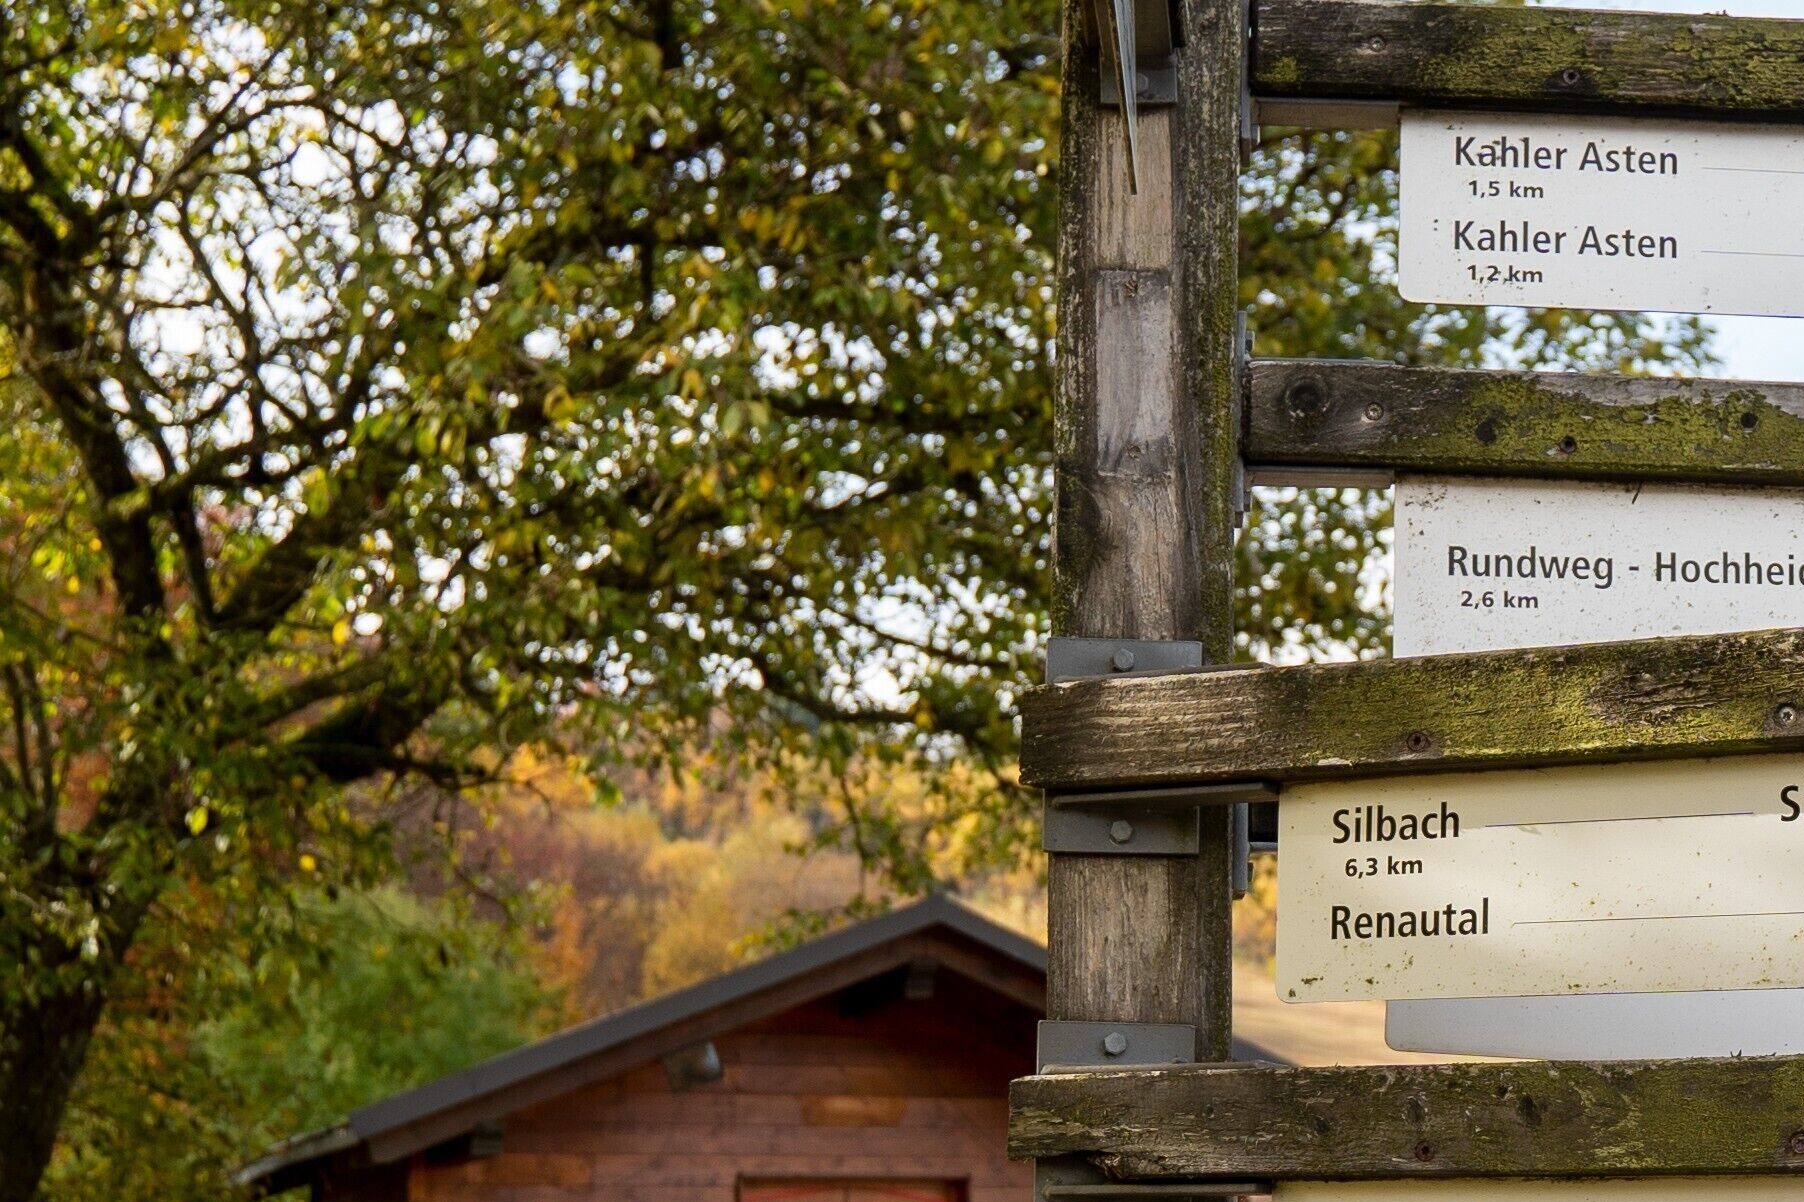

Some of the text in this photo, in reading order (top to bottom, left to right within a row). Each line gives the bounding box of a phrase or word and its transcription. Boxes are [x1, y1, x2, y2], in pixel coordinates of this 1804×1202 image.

[1455, 135, 1678, 175] Kahler Asten
[1468, 180, 1544, 199] 1,5 km
[1454, 219, 1677, 259] Kahler Asten
[1466, 264, 1543, 285] 1,2 km
[1448, 545, 1613, 590] Rundweg
[1460, 590, 1539, 610] 2,6 km
[1332, 801, 1460, 844] Silbach
[1345, 855, 1423, 880] 6,3 km
[1331, 897, 1489, 940] Renautal
